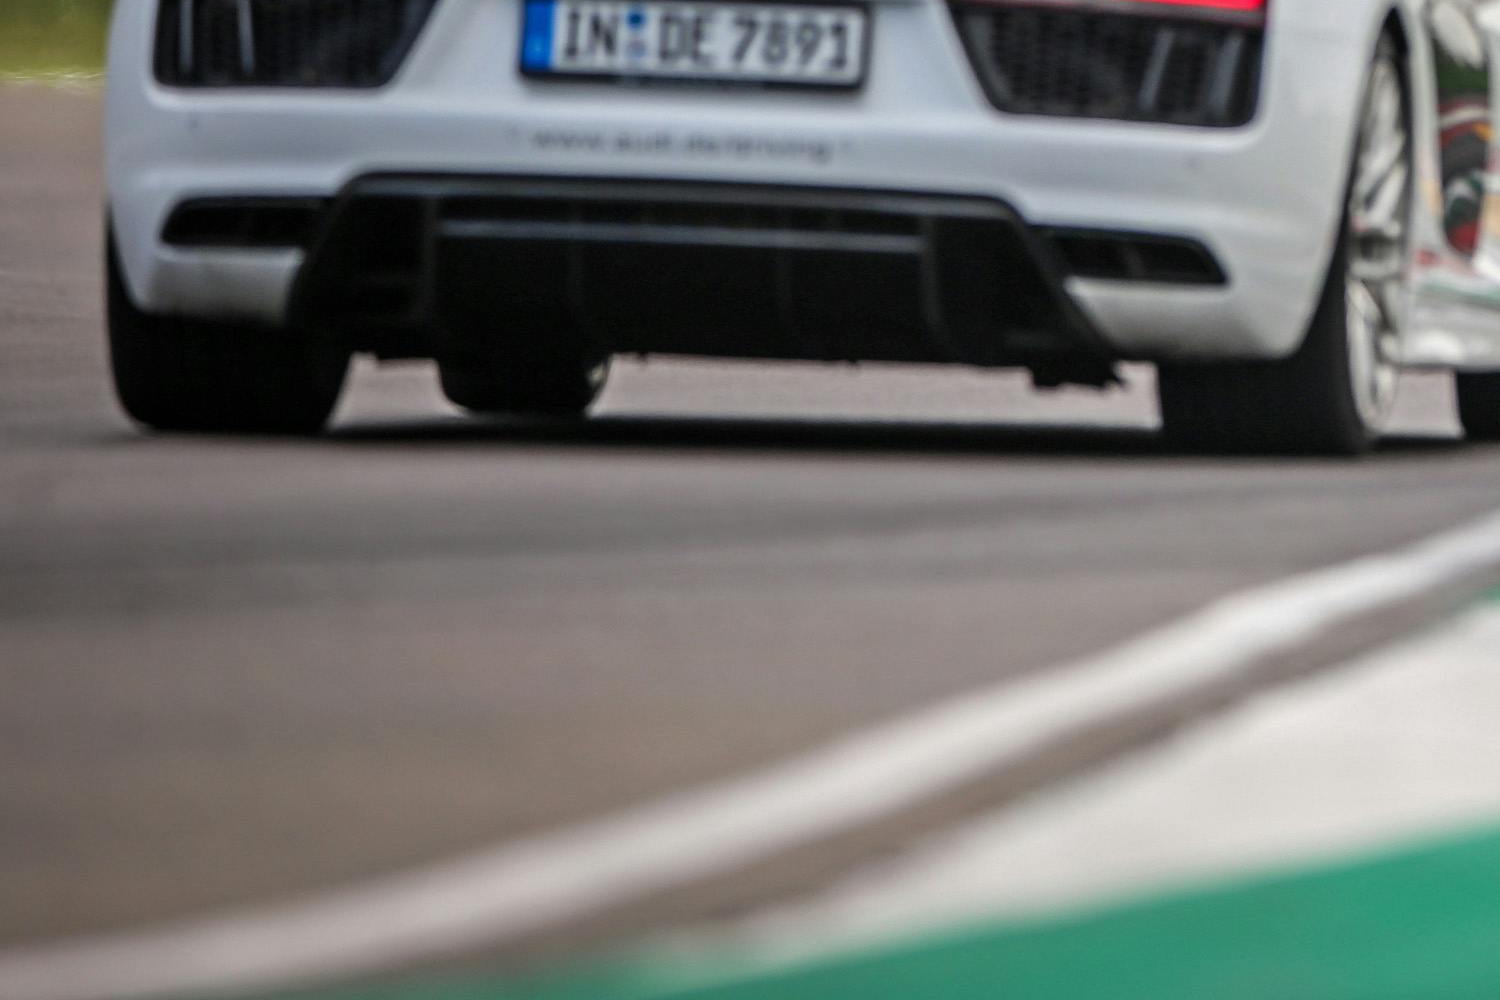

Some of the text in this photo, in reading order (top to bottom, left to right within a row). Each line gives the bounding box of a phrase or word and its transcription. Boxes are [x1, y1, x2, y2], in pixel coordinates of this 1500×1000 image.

[563, 6, 850, 72] IN DE 7891
